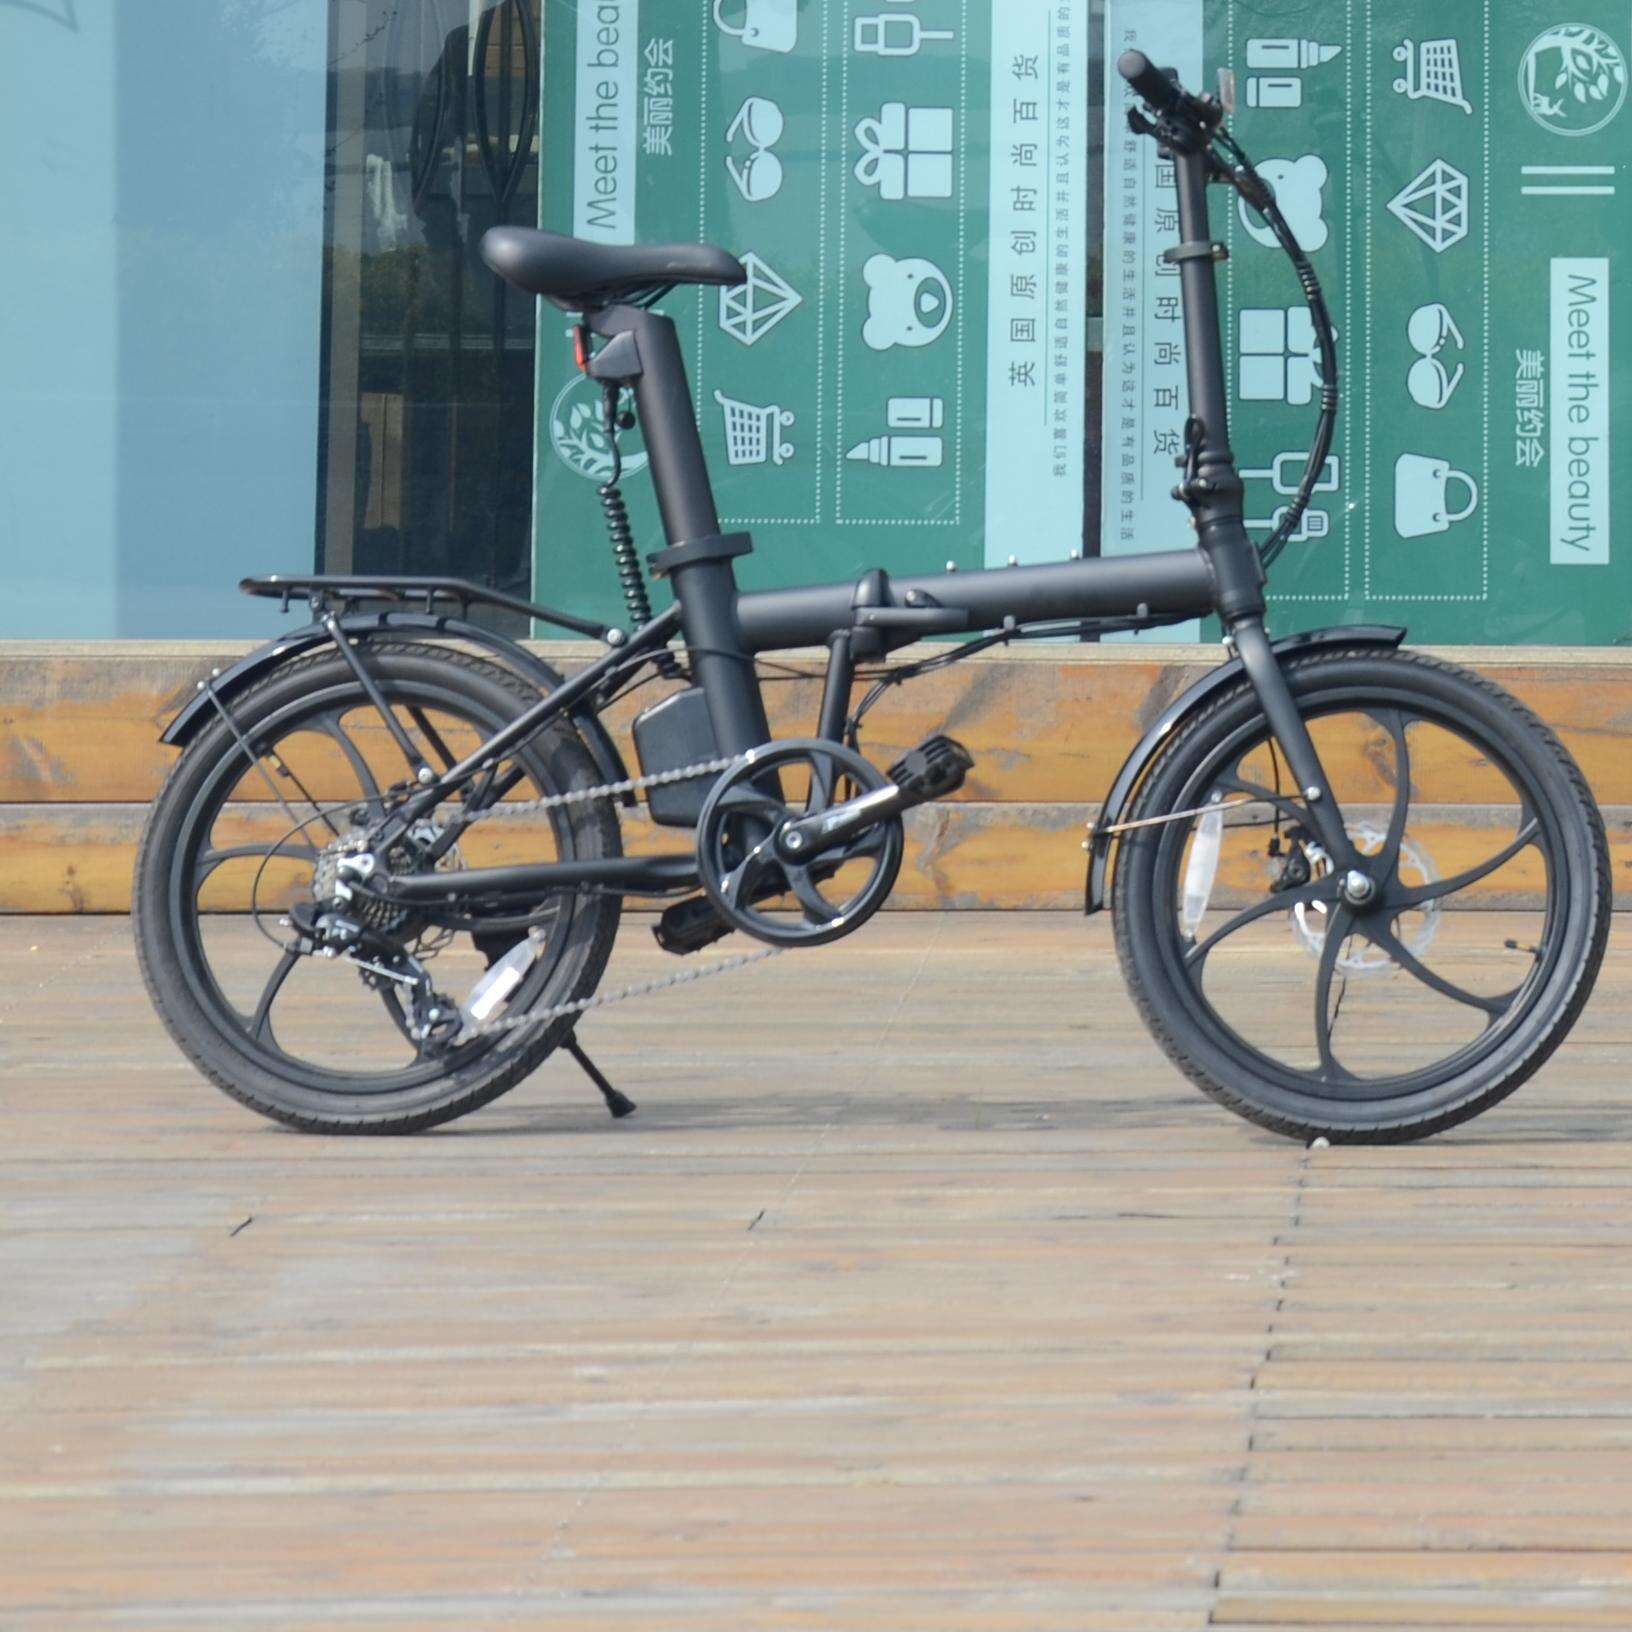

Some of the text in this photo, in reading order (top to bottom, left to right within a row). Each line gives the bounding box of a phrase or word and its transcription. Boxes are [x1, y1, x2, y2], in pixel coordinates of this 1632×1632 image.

[585, 80, 619, 132] the
[642, 37, 675, 156] 美丽约会
[585, 144, 618, 230] Meet
[1008, 53, 1039, 388] 英国原创时尚百货
[1153, 164, 1182, 455] 国原创时尚百货
[1515, 348, 1546, 468] 美丽约会
[1559, 274, 1600, 552] Meet the beauty
